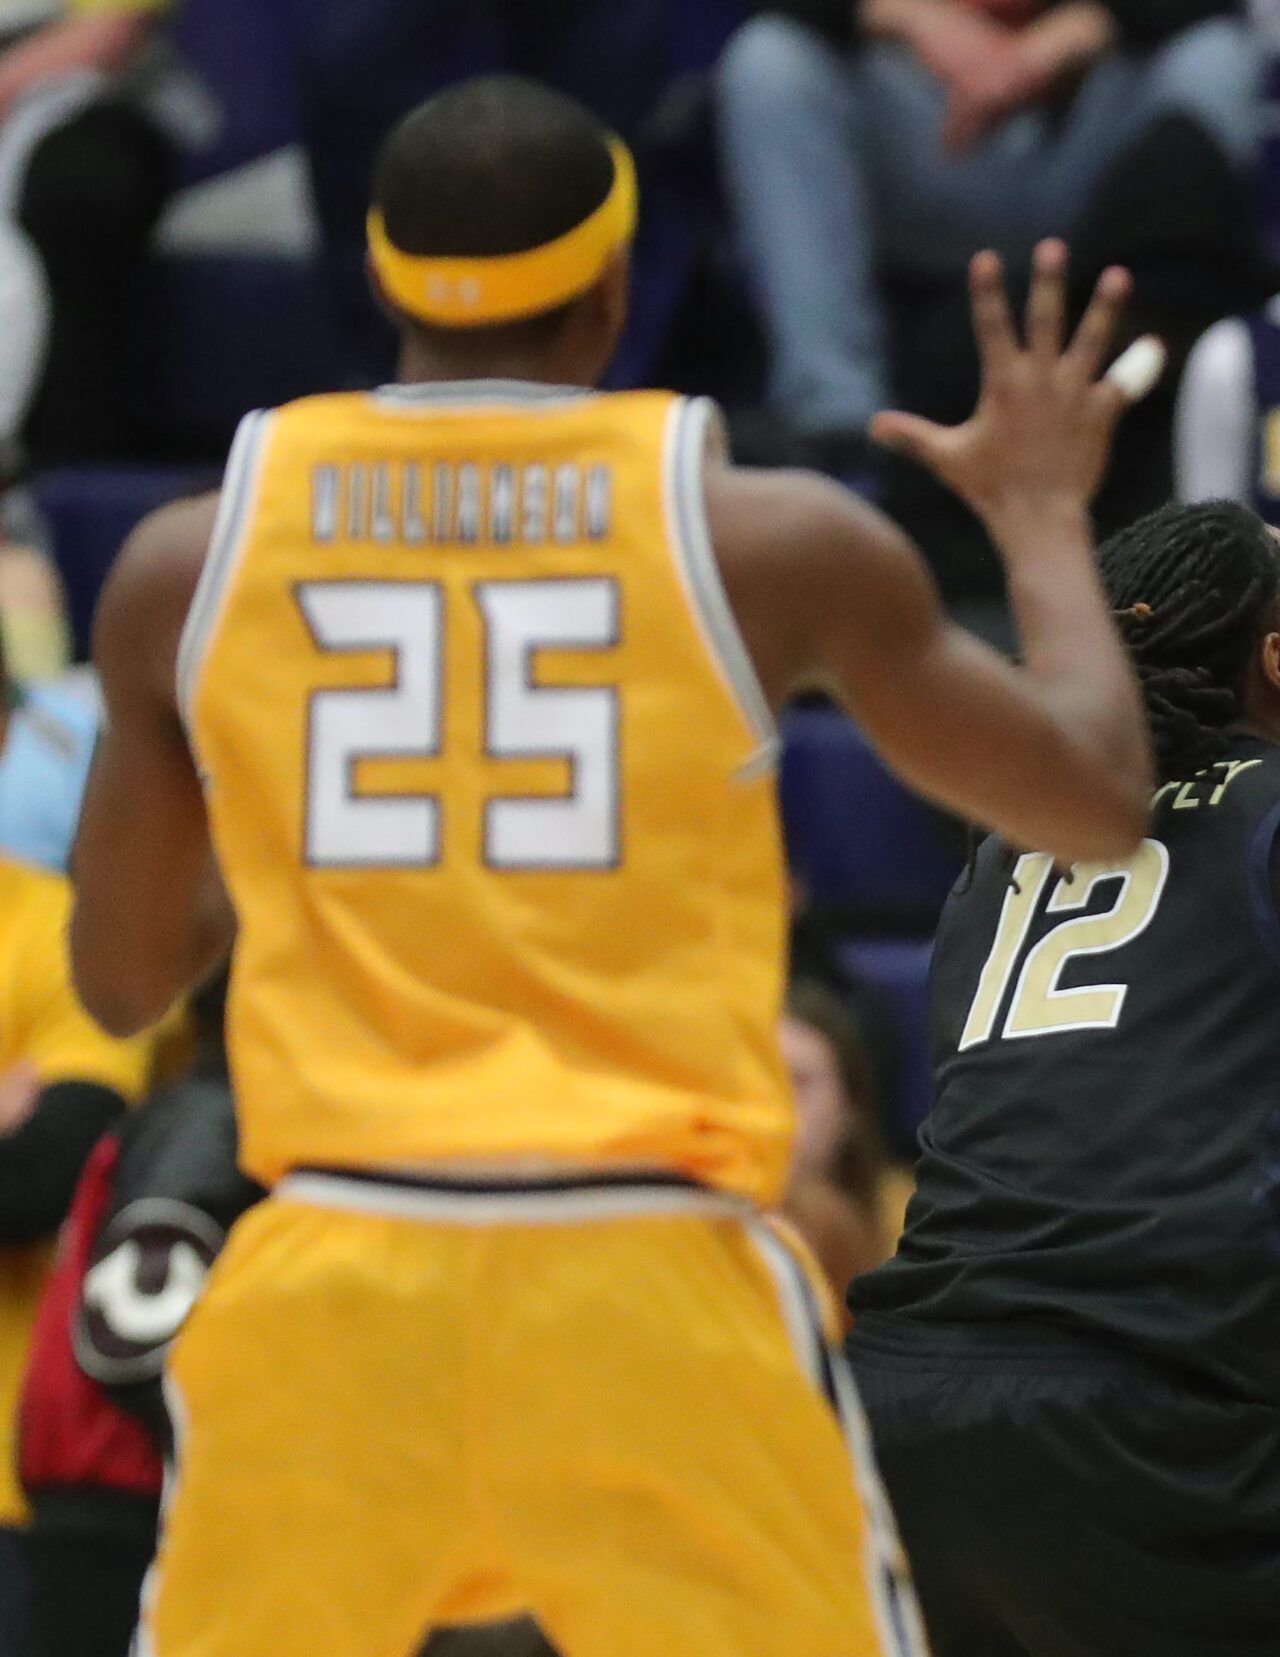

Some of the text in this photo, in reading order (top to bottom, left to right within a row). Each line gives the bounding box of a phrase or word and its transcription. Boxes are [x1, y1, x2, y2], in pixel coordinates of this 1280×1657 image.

[312, 461, 610, 544] WILLIAMSON
[292, 577, 622, 868] 25
[958, 837, 1170, 1052] 12
